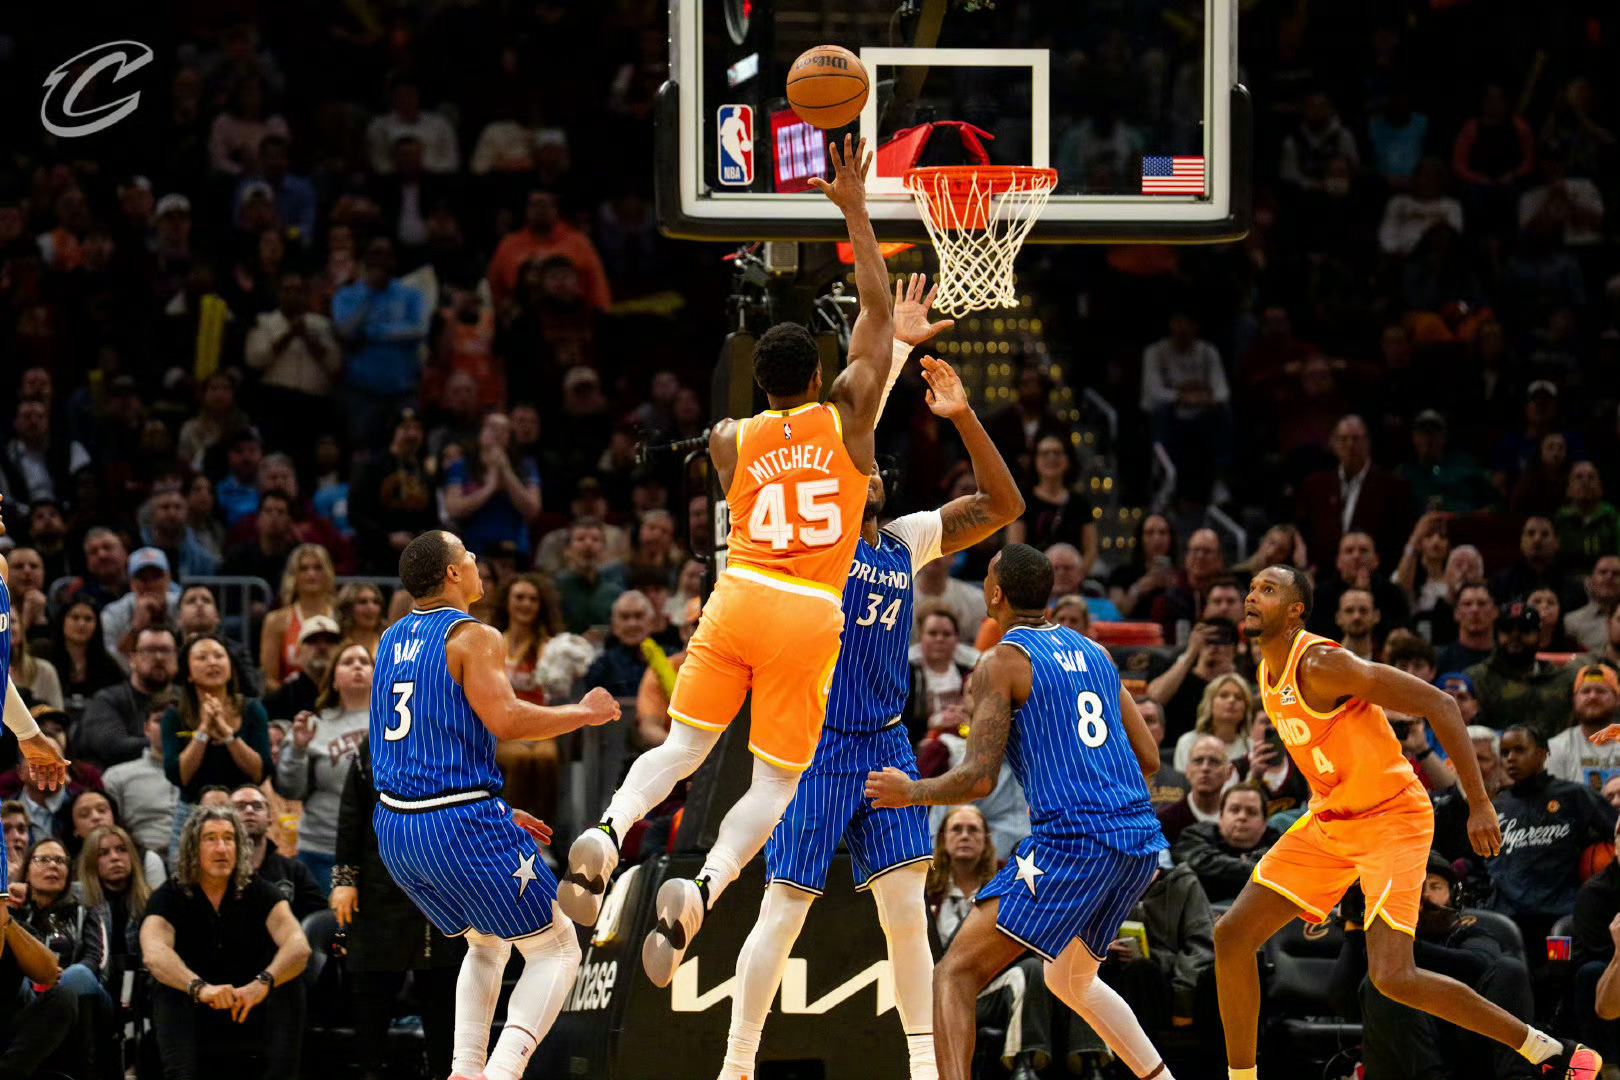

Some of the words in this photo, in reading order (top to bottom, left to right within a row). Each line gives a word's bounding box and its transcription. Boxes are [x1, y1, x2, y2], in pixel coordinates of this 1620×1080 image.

[796, 55, 848, 70] Wilson
[724, 166, 741, 180] NBA
[746, 444, 834, 486] MITCHELL
[748, 477, 842, 551] 45
[856, 592, 902, 632] 34
[384, 680, 415, 742] 3
[1077, 690, 1109, 749] 8
[1312, 745, 1335, 775] 4
